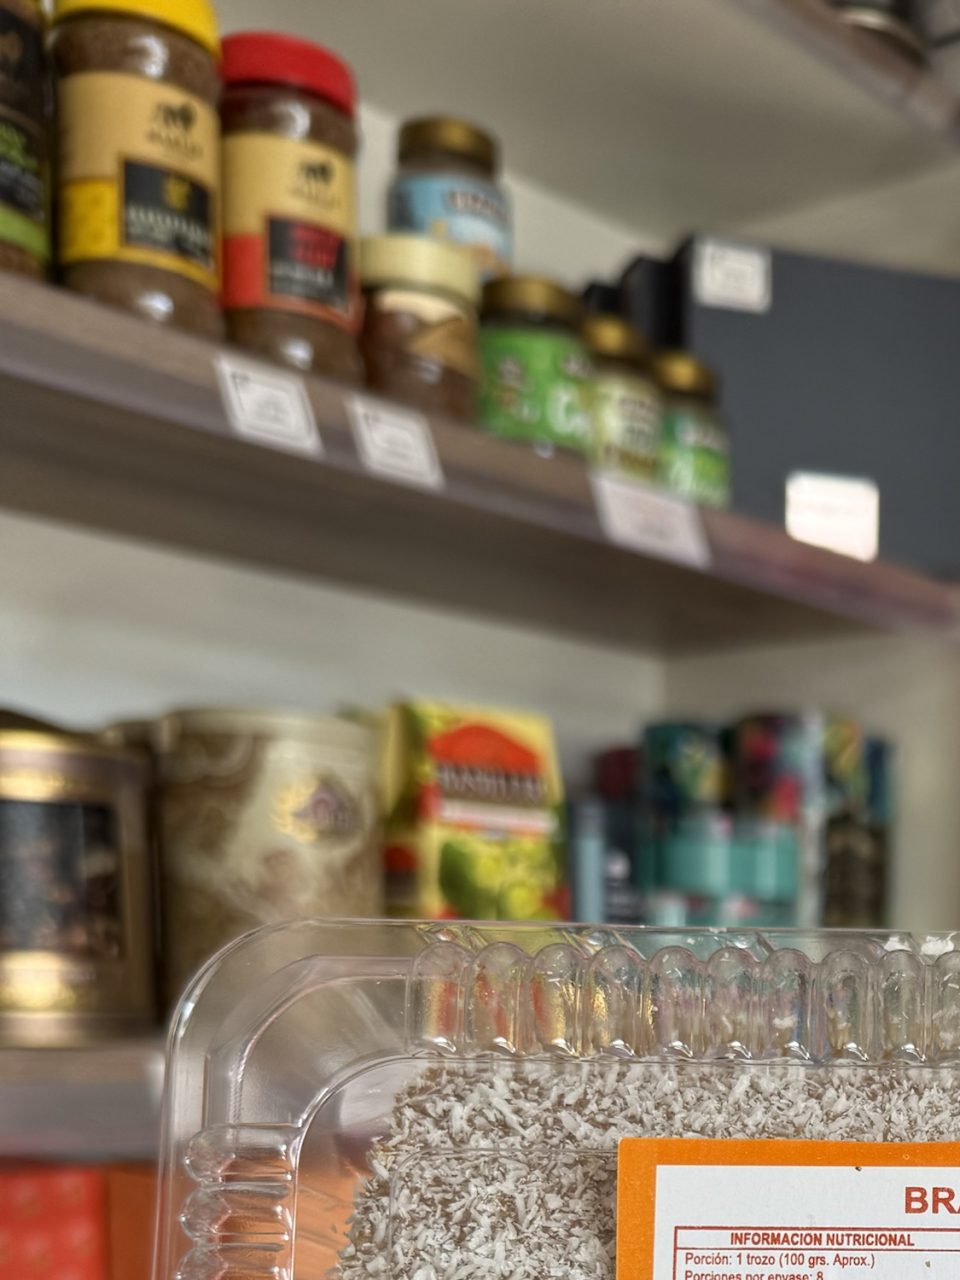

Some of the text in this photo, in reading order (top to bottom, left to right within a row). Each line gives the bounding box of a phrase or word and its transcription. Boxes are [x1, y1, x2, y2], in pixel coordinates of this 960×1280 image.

[826, 1233, 915, 1246] NUTRICIONAL
[685, 1252, 875, 1269] Porción: 1 trozo (100 grs. Aprox.)
